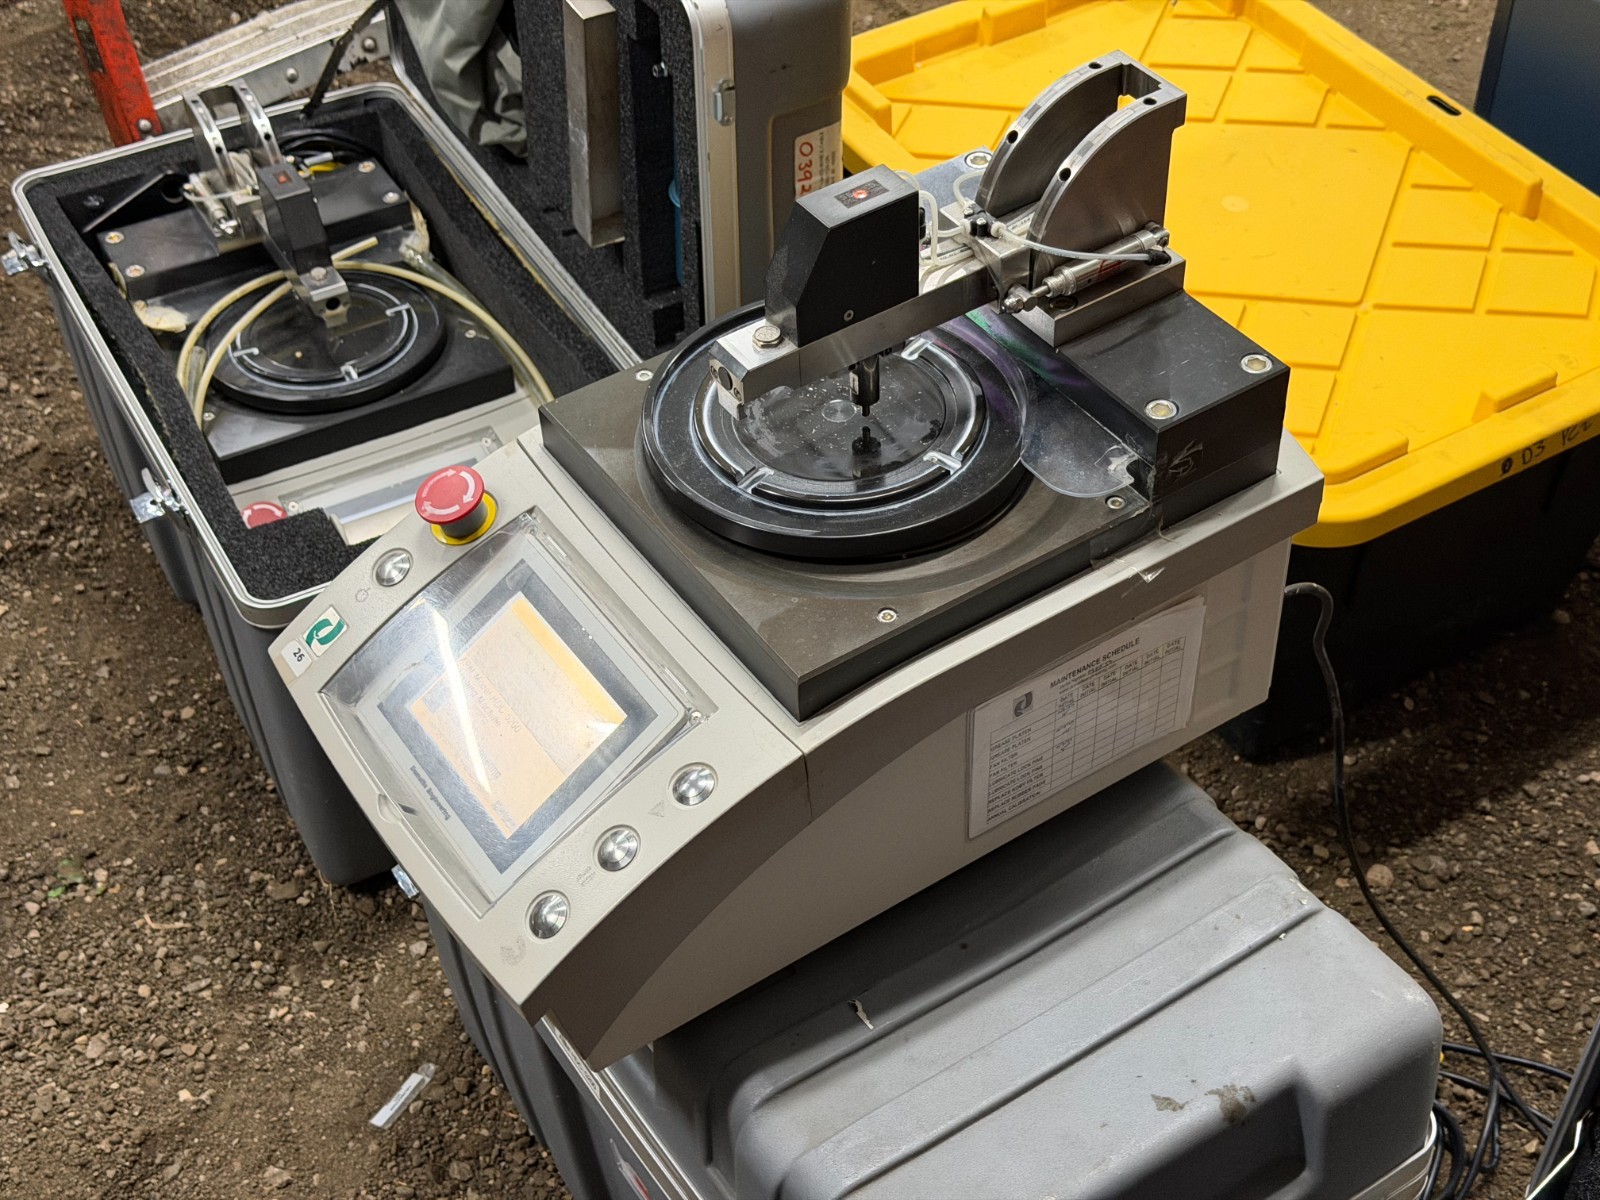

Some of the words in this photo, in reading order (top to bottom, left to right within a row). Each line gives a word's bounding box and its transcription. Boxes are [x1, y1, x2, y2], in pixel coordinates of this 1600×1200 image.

[293, 647, 306, 663] 26
[1050, 657, 1101, 688] MAINTENANCE
[1102, 637, 1141, 662] SCHEDULE
[1012, 728, 1032, 739] PLATEN
[1012, 737, 1031, 749] PLATEN
[1001, 752, 1018, 762] FILTER
[1001, 761, 1018, 771] FILTER
